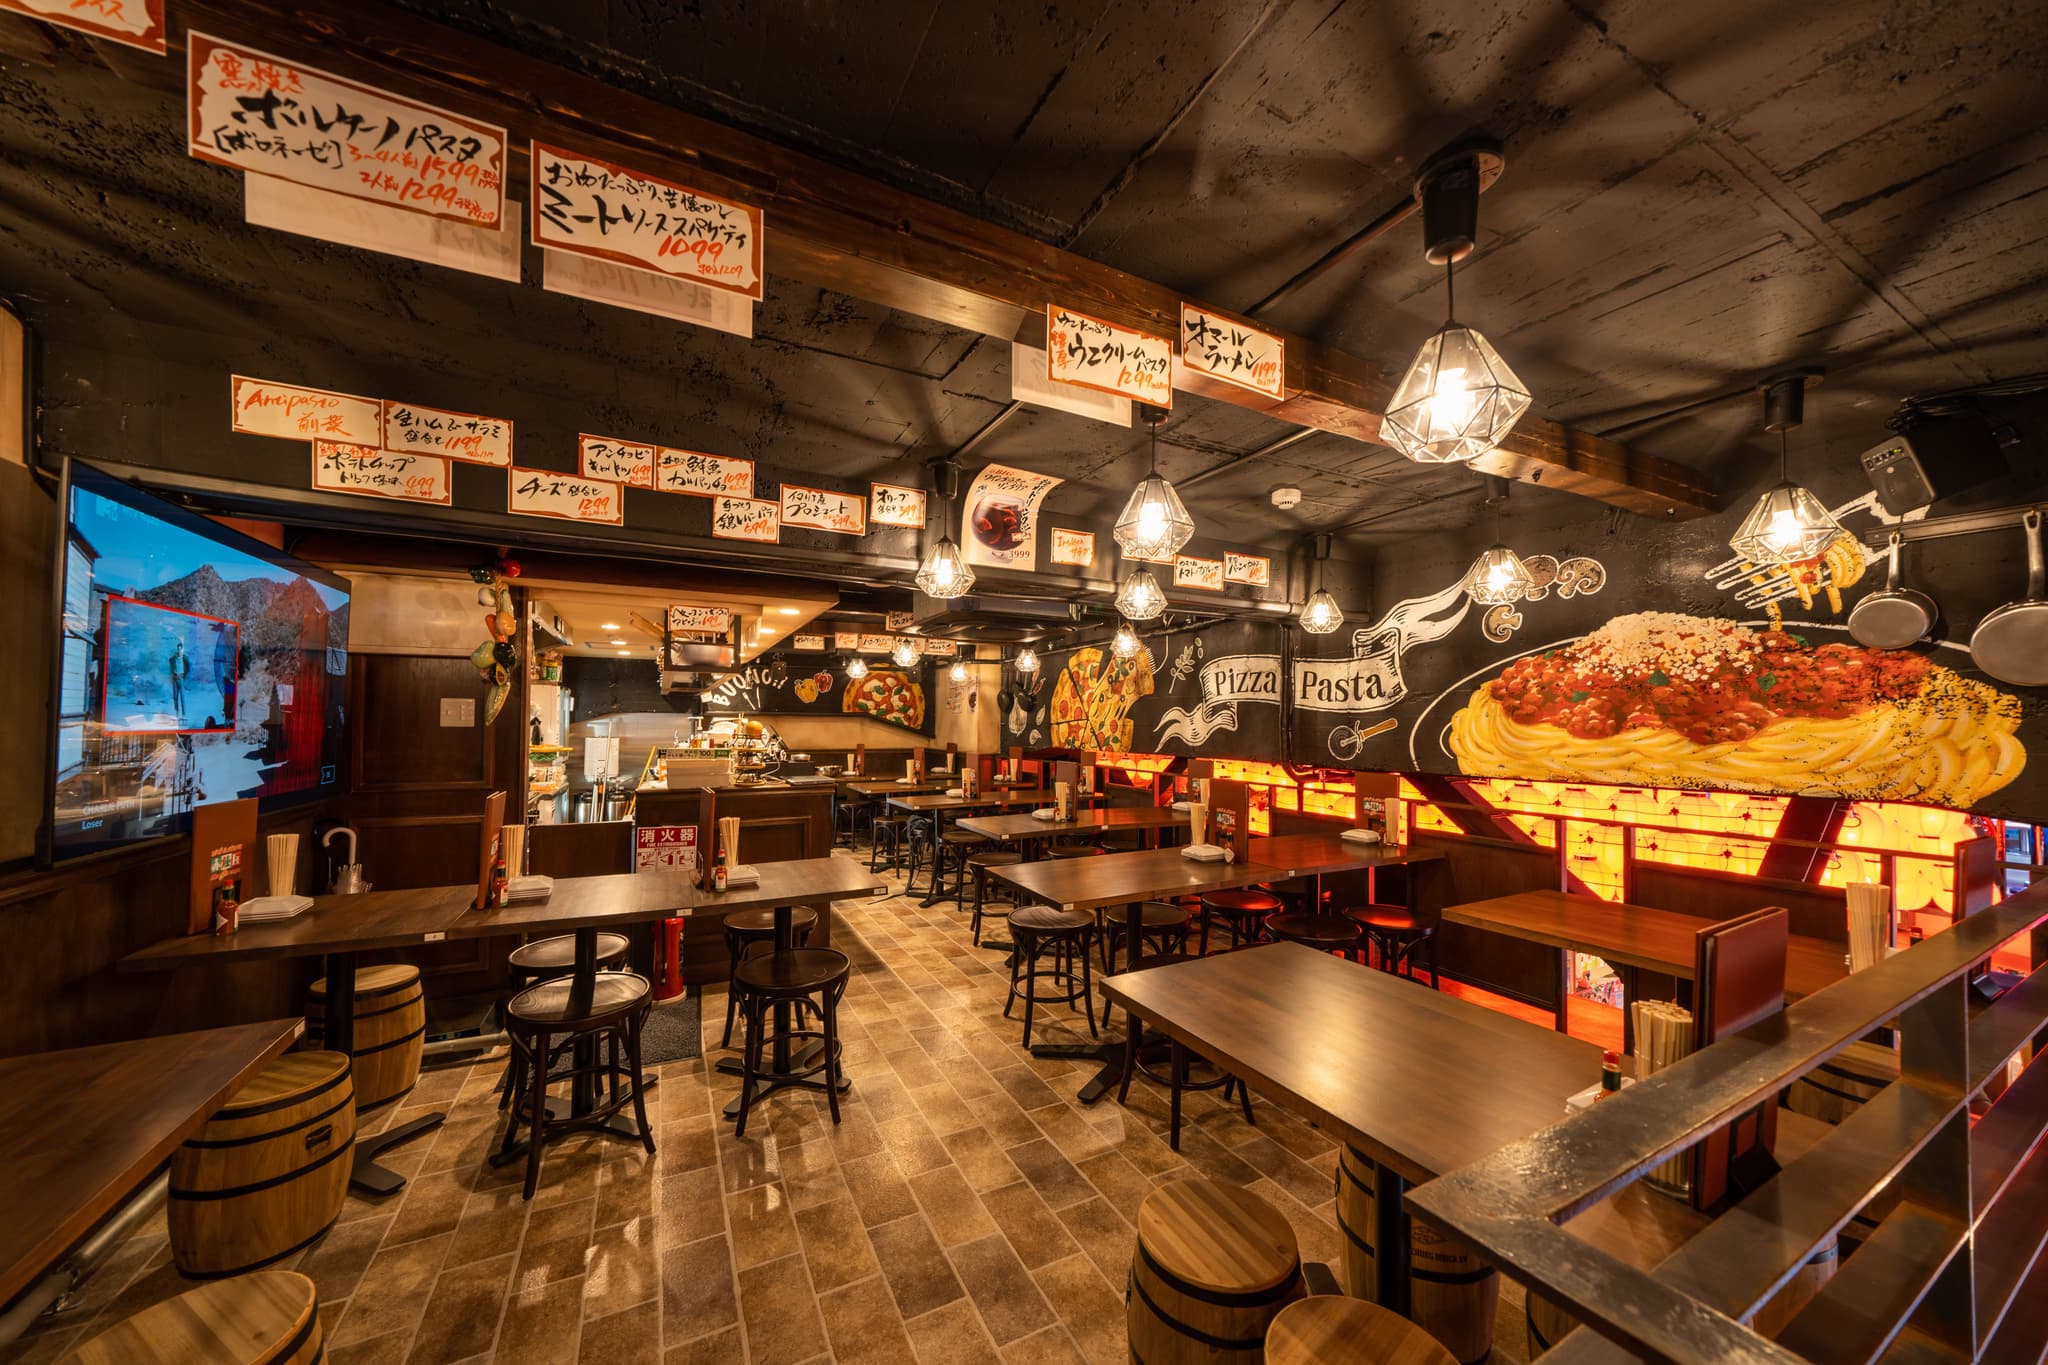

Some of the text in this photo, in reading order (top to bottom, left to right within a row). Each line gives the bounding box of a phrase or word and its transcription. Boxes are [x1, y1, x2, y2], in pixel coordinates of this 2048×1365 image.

[420, 155, 480, 186] 1599
[400, 178, 458, 208] 1299
[658, 235, 723, 264] 1099
[1185, 315, 1253, 347] オマール
[1204, 345, 1266, 372] ラーメン
[1252, 361, 1277, 379] 1199
[1117, 365, 1152, 389] 1299
[244, 389, 340, 416] Antipasto
[297, 411, 352, 437] 前菜
[445, 435, 483, 450] 1199
[723, 472, 749, 485] 1099
[578, 496, 610, 511] 1299
[877, 489, 909, 503] オリーブ
[786, 501, 849, 517] プロシュート
[1215, 668, 1277, 696] Pizza
[1300, 670, 1386, 702] Pasta
[82, 819, 103, 830] Loser
[640, 829, 694, 842] 消火器
